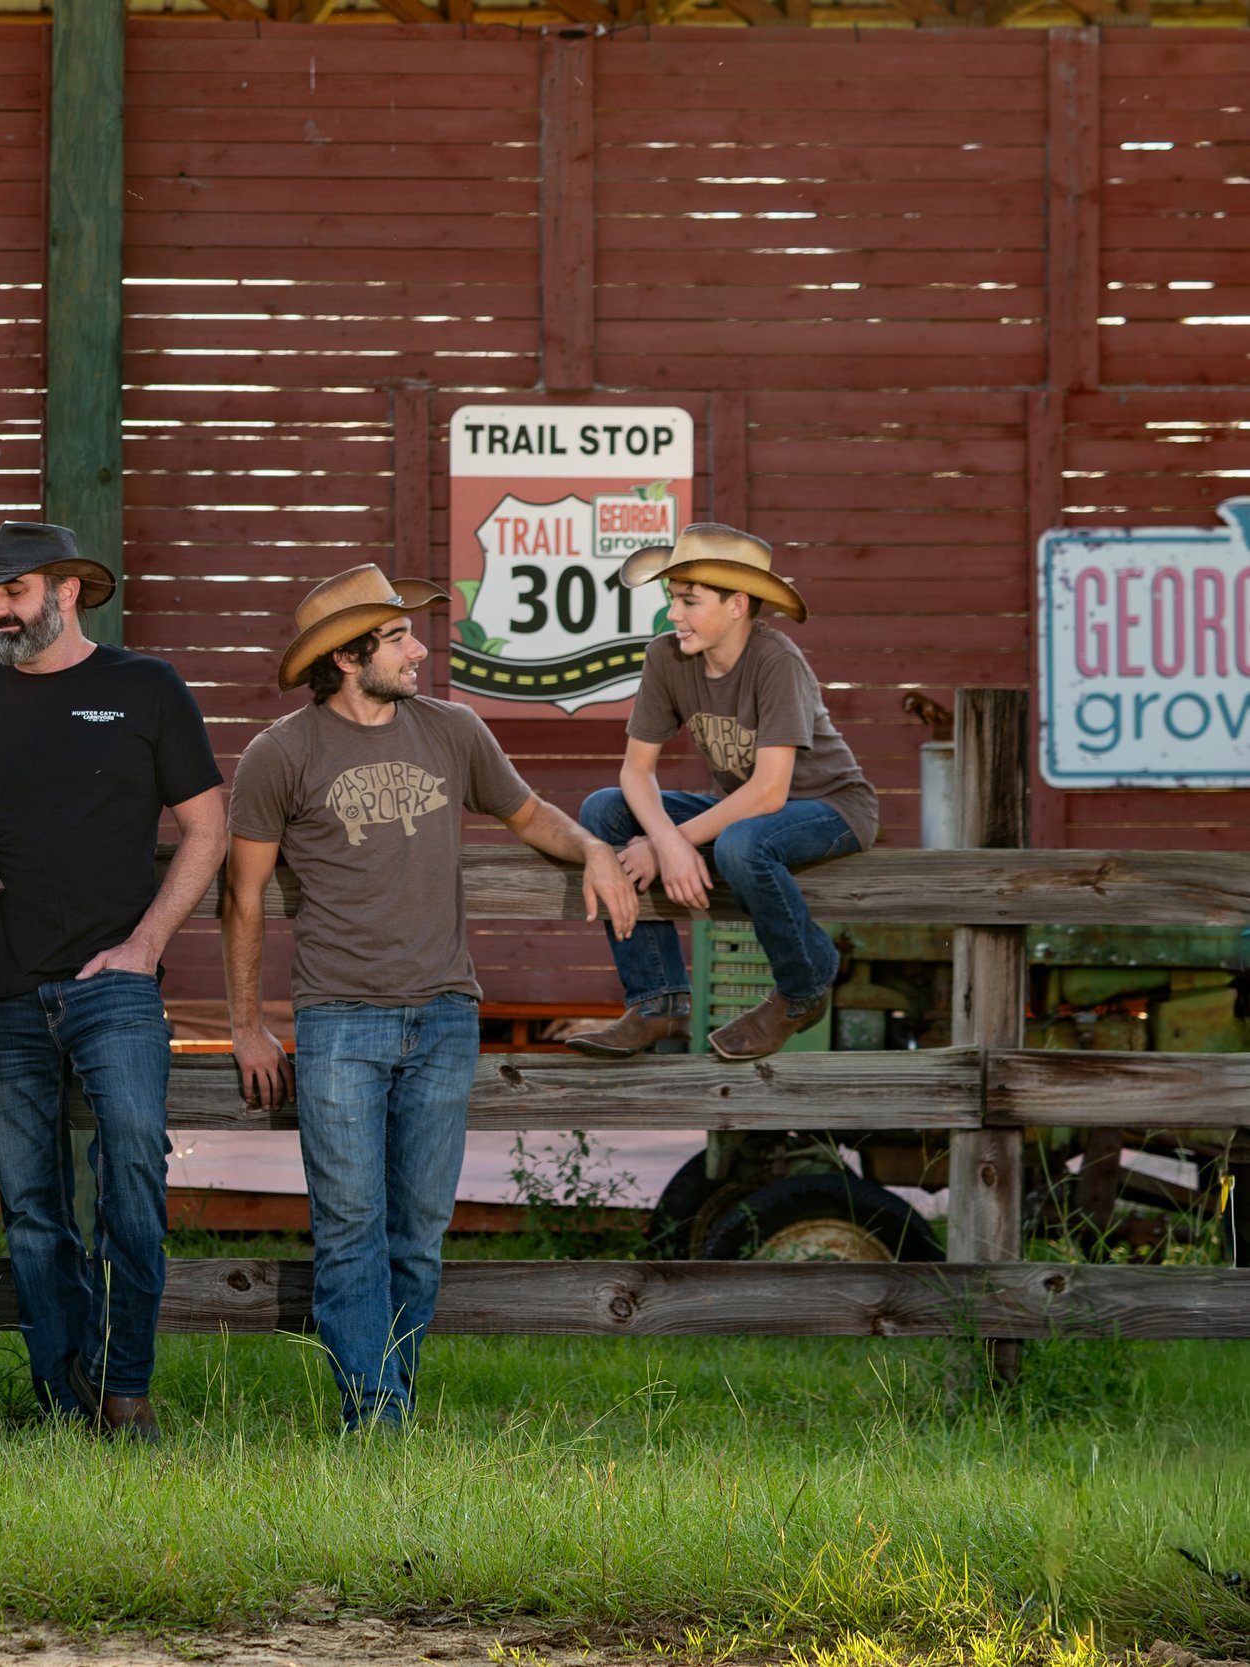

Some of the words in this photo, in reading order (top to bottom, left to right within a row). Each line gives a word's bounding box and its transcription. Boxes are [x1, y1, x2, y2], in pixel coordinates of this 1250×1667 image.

[464, 424, 567, 455] TRAIL
[579, 425, 674, 456] STOP
[494, 517, 581, 556] TRAIL
[600, 504, 669, 532] GEORGIA
[509, 564, 632, 634] 301
[332, 762, 436, 812] PASTURED
[360, 787, 431, 822] PORK
